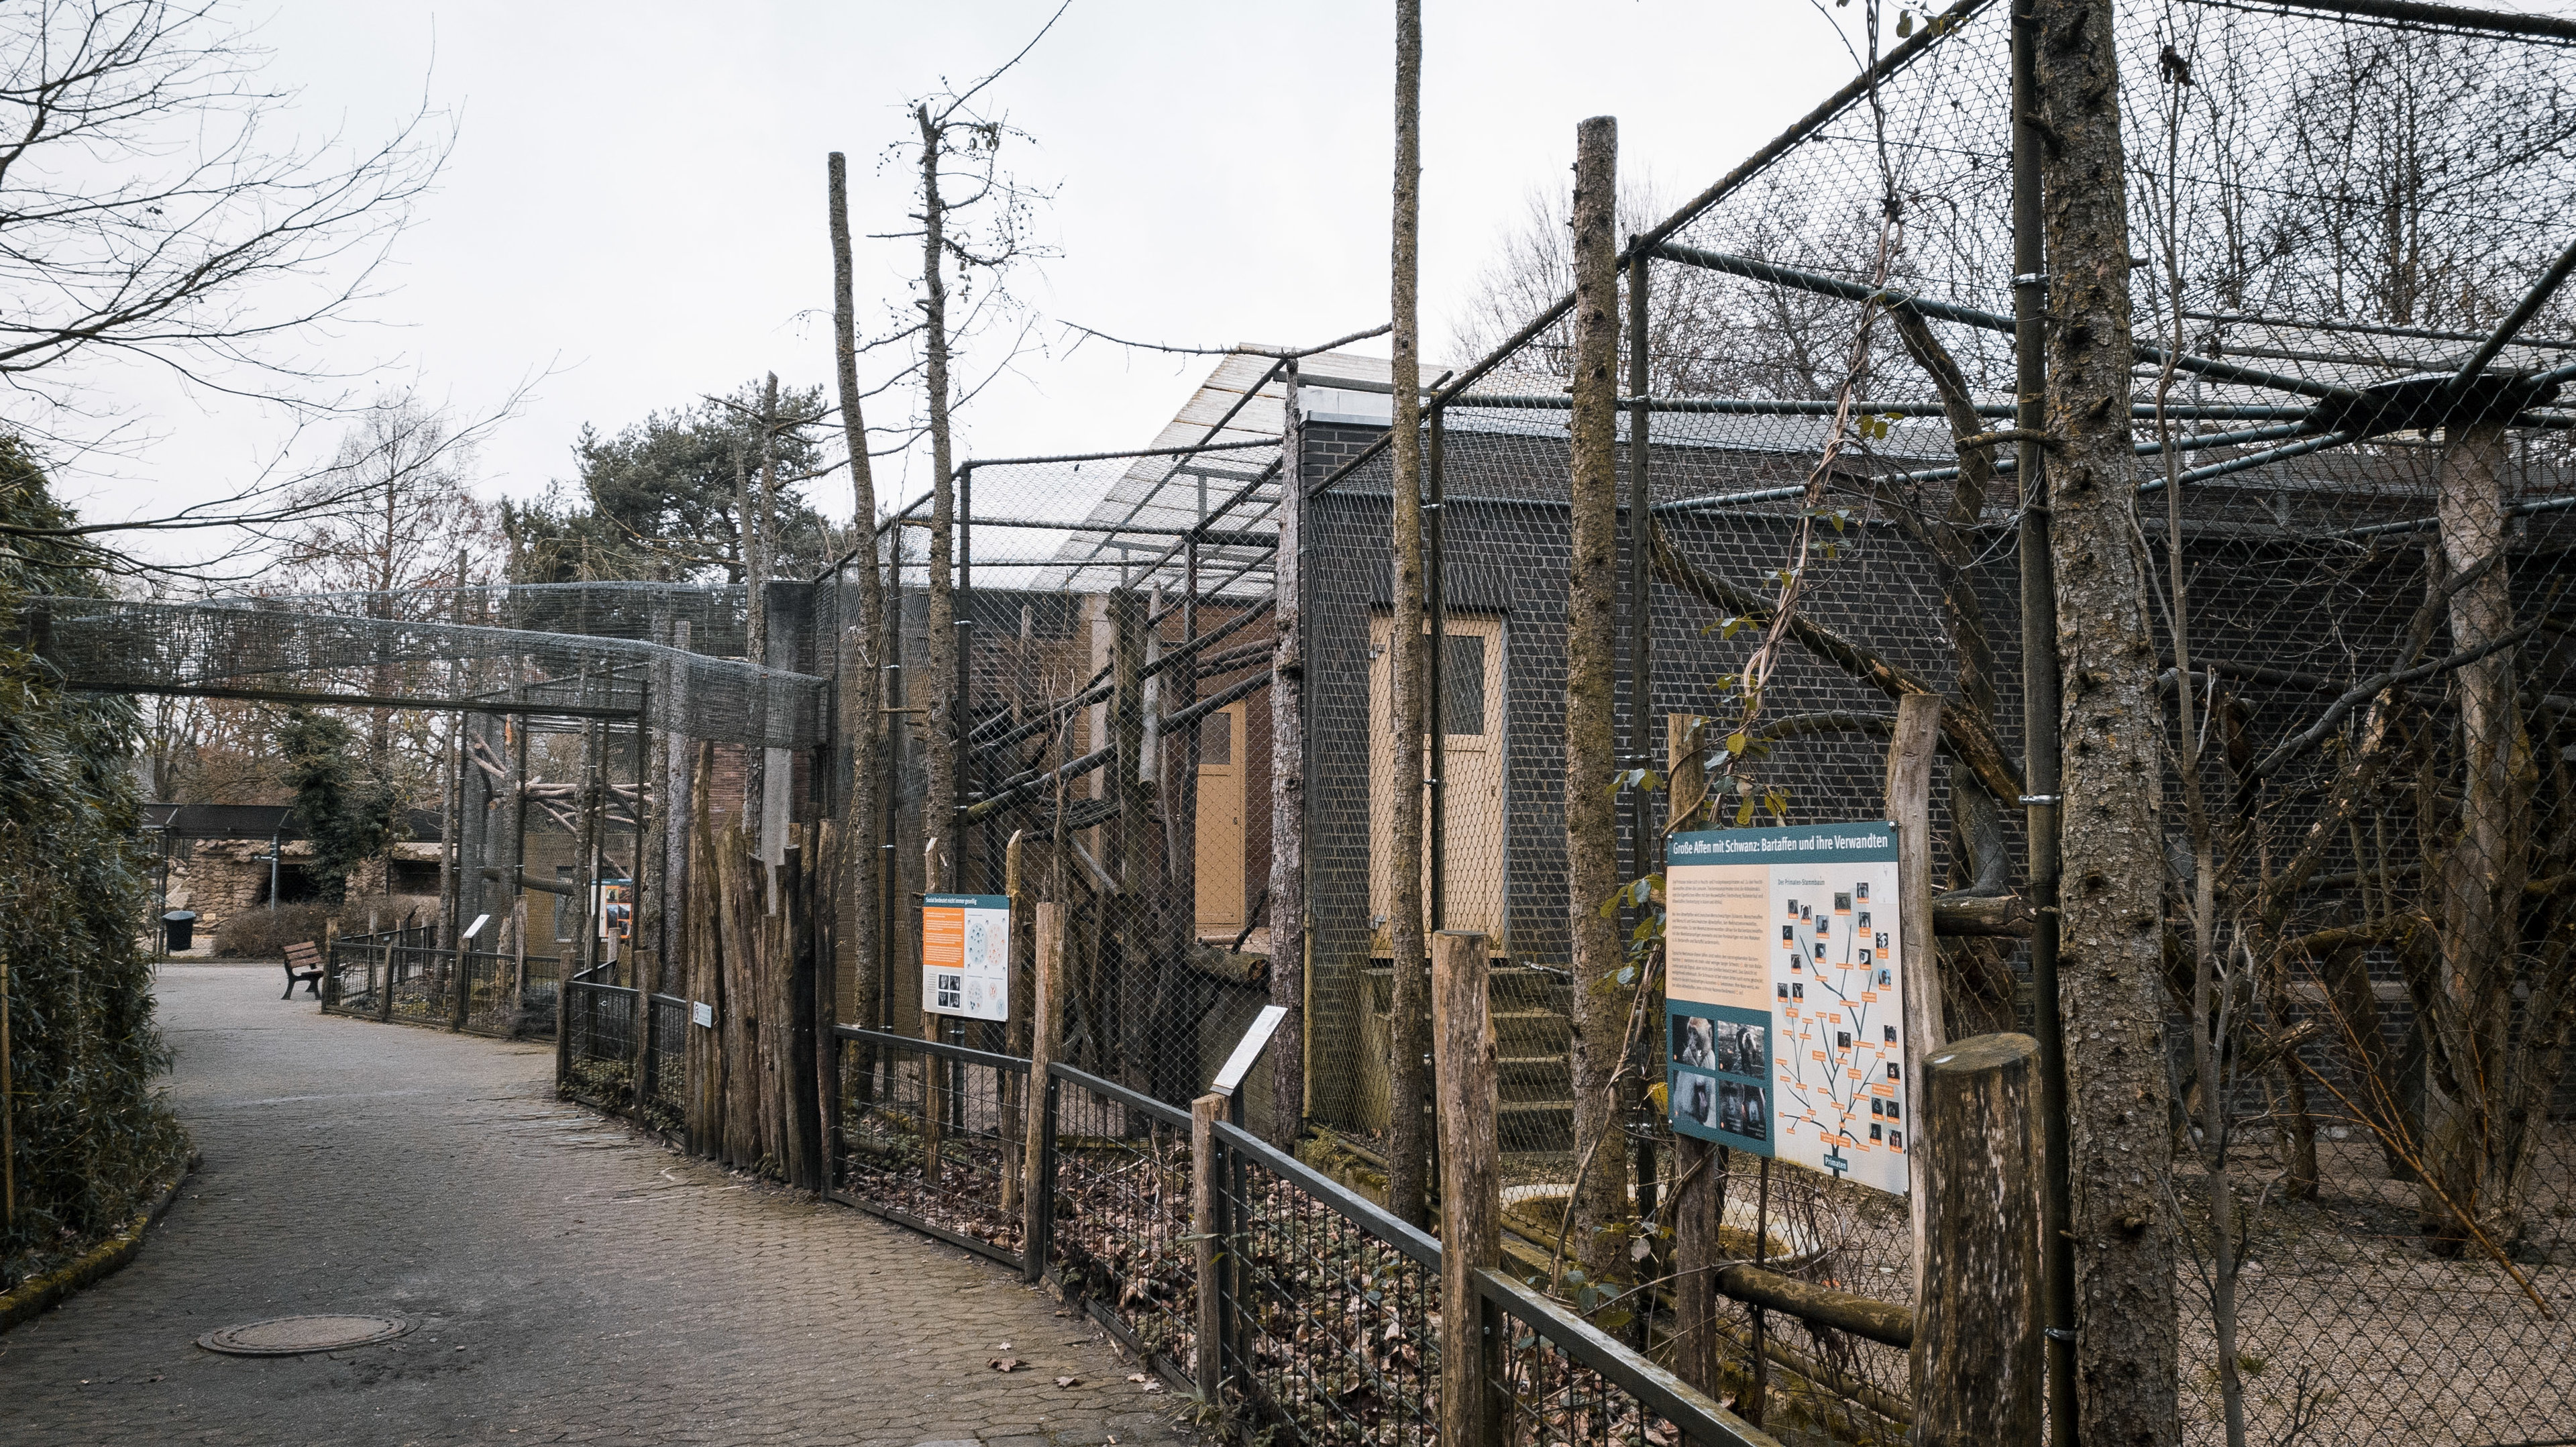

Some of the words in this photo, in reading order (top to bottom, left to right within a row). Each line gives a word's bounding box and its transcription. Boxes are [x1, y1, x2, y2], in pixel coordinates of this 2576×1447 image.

[1673, 842, 1693, 855] Große
[1693, 840, 1711, 854] Affen
[1713, 840, 1725, 853] mit
[1725, 839, 1760, 853] Schwanz:
[1761, 836, 1797, 851] Bartaffen
[1799, 835, 1815, 850] und
[1815, 835, 1833, 849] ihre
[1834, 833, 1888, 849] Verwandten
[1825, 1157, 1847, 1170] Primaten
